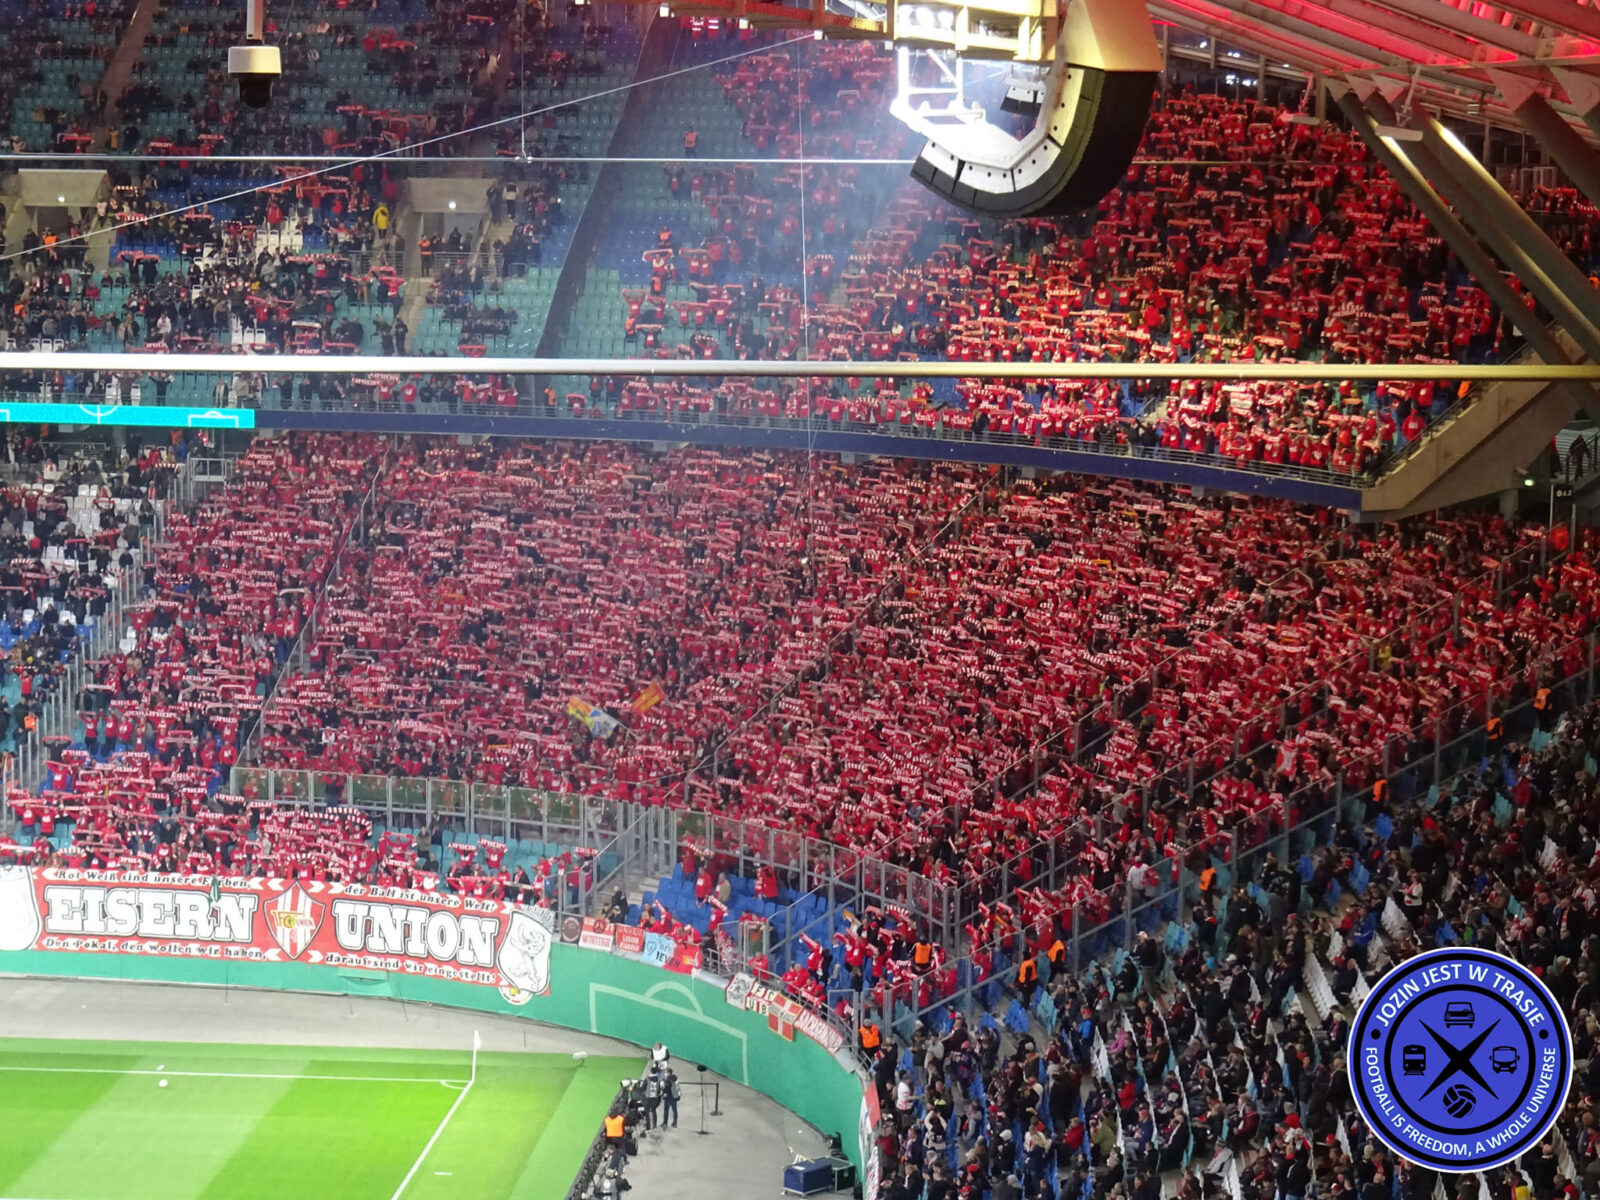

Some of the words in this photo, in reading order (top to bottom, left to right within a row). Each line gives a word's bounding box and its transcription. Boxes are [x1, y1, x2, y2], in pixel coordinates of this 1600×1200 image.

[58, 870, 117, 882] Rot-Weiß
[121, 873, 149, 882] sind
[154, 876, 197, 885] unsere
[345, 885, 365, 895] der
[371, 887, 397, 897] Ball
[399, 889, 416, 899] ist
[419, 893, 460, 906] unsere
[464, 900, 496, 911] Welt!
[44, 885, 259, 943] EISERN
[331, 899, 500, 967] UNION
[46, 938, 71, 948] Den
[75, 939, 116, 951] Pokal,
[121, 941, 144, 951] den
[149, 943, 192, 953] wollen
[198, 945, 220, 956] wir
[225, 946, 267, 960] haben,
[325, 953, 369, 966] darauf
[373, 958, 399, 968] sind
[405, 961, 424, 972] wir
[427, 965, 496, 983] eingestellt!
